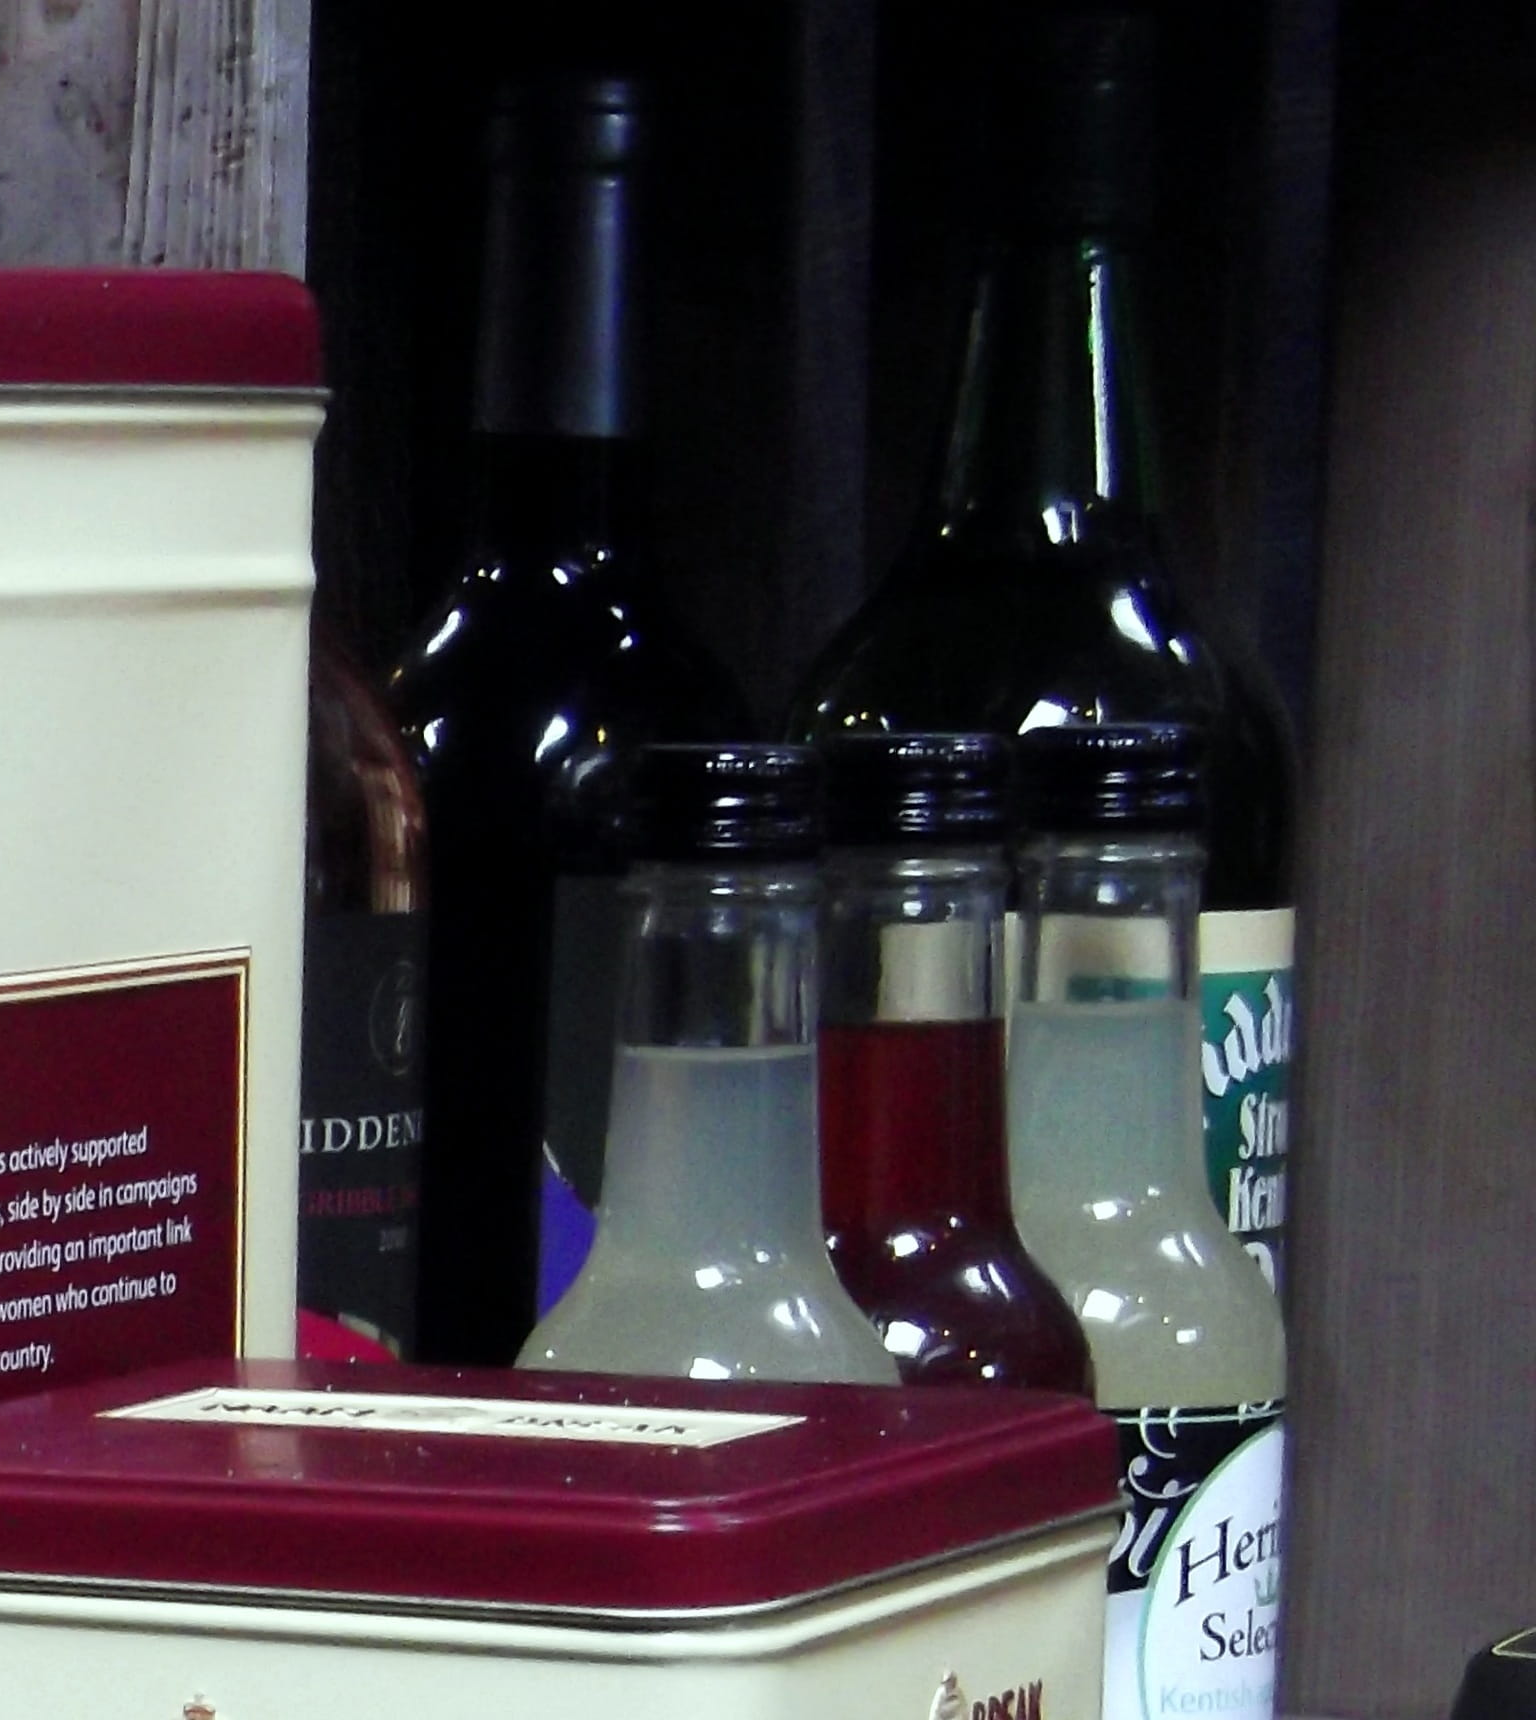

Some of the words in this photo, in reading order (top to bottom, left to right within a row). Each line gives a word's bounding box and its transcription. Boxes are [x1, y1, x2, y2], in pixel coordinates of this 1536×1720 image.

[9, 1136, 69, 1173] actively
[71, 1125, 148, 1168] supported
[300, 1108, 423, 1154] IDDEN
[1238, 1091, 1288, 1160] Str
[8, 1190, 39, 1223] side
[42, 1188, 62, 1224] by
[65, 1182, 96, 1214] side
[99, 1182, 113, 1208] in
[116, 1171, 198, 1208] campaigns
[1228, 1167, 1286, 1232] Ken
[64, 1239, 85, 1263] an
[88, 1224, 163, 1263] important
[166, 1215, 193, 1246] link
[55, 1282, 88, 1312] who
[91, 1275, 157, 1306] continue
[160, 1271, 177, 1296] to
[1174, 1501, 1278, 1608] Heri
[1200, 1609, 1276, 1663] Selec
